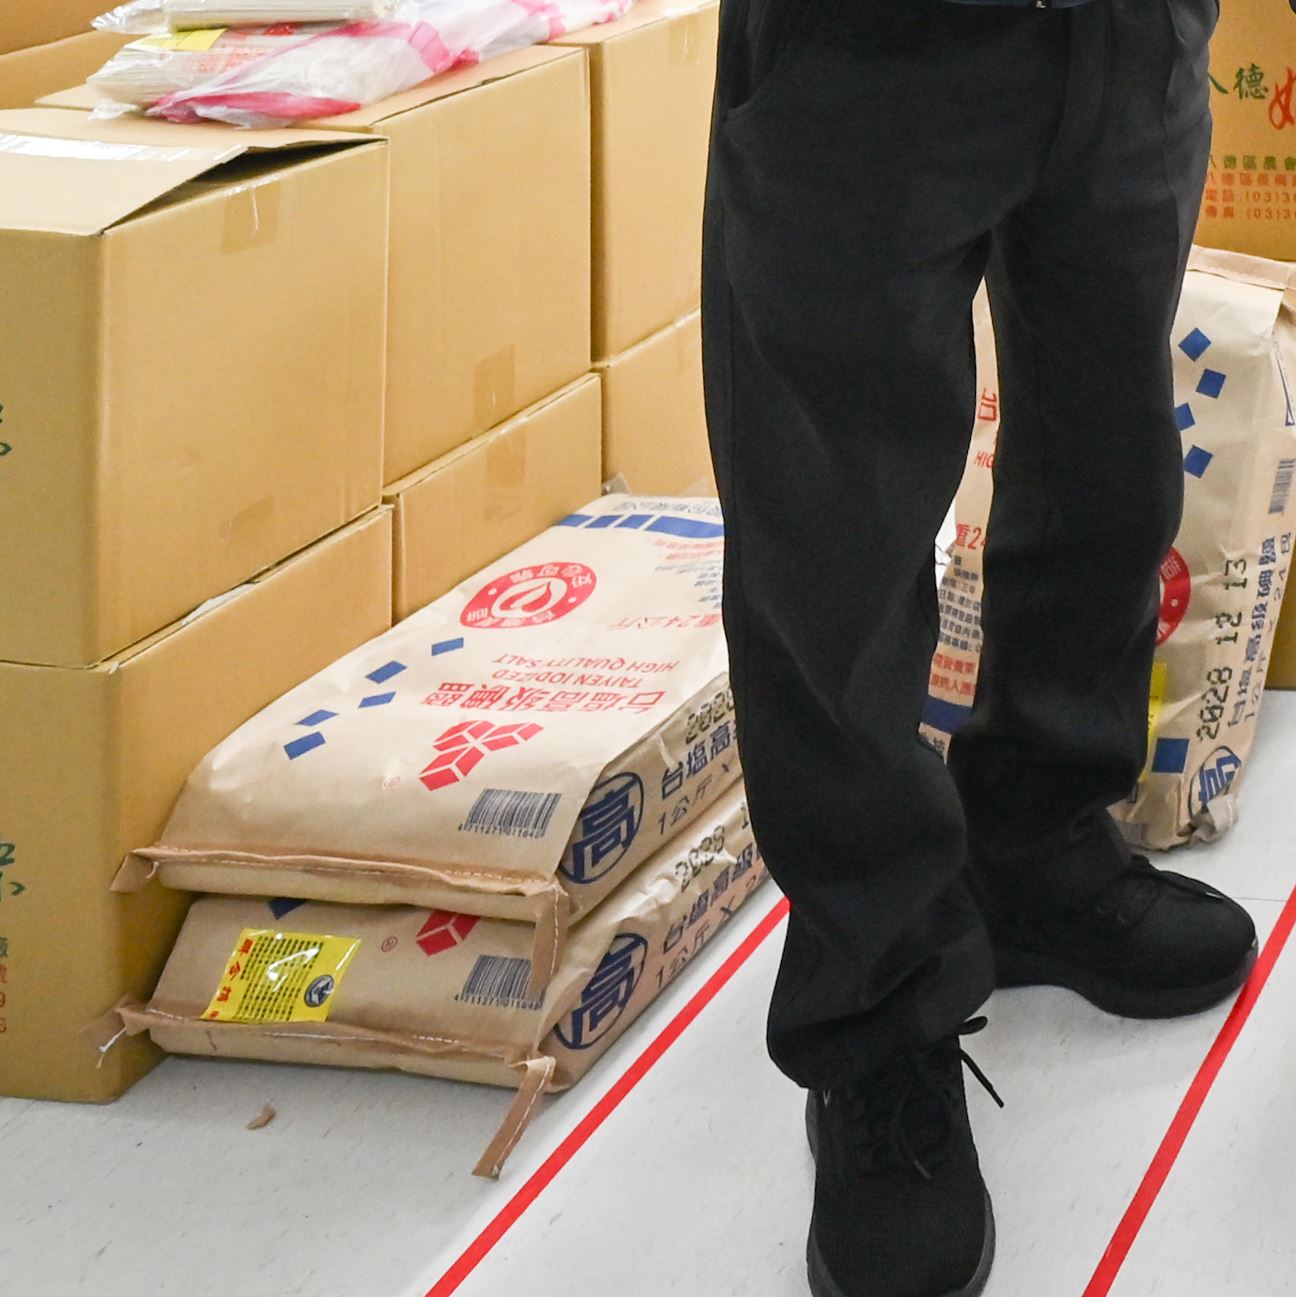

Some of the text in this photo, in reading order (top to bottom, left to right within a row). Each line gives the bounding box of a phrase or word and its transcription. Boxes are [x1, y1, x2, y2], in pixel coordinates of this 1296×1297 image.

[492, 654, 680, 673] HIGH QUALITY SALT
[492, 671, 643, 689] TAIYEN IODIZED
[662, 720, 736, 800] 台塩高
